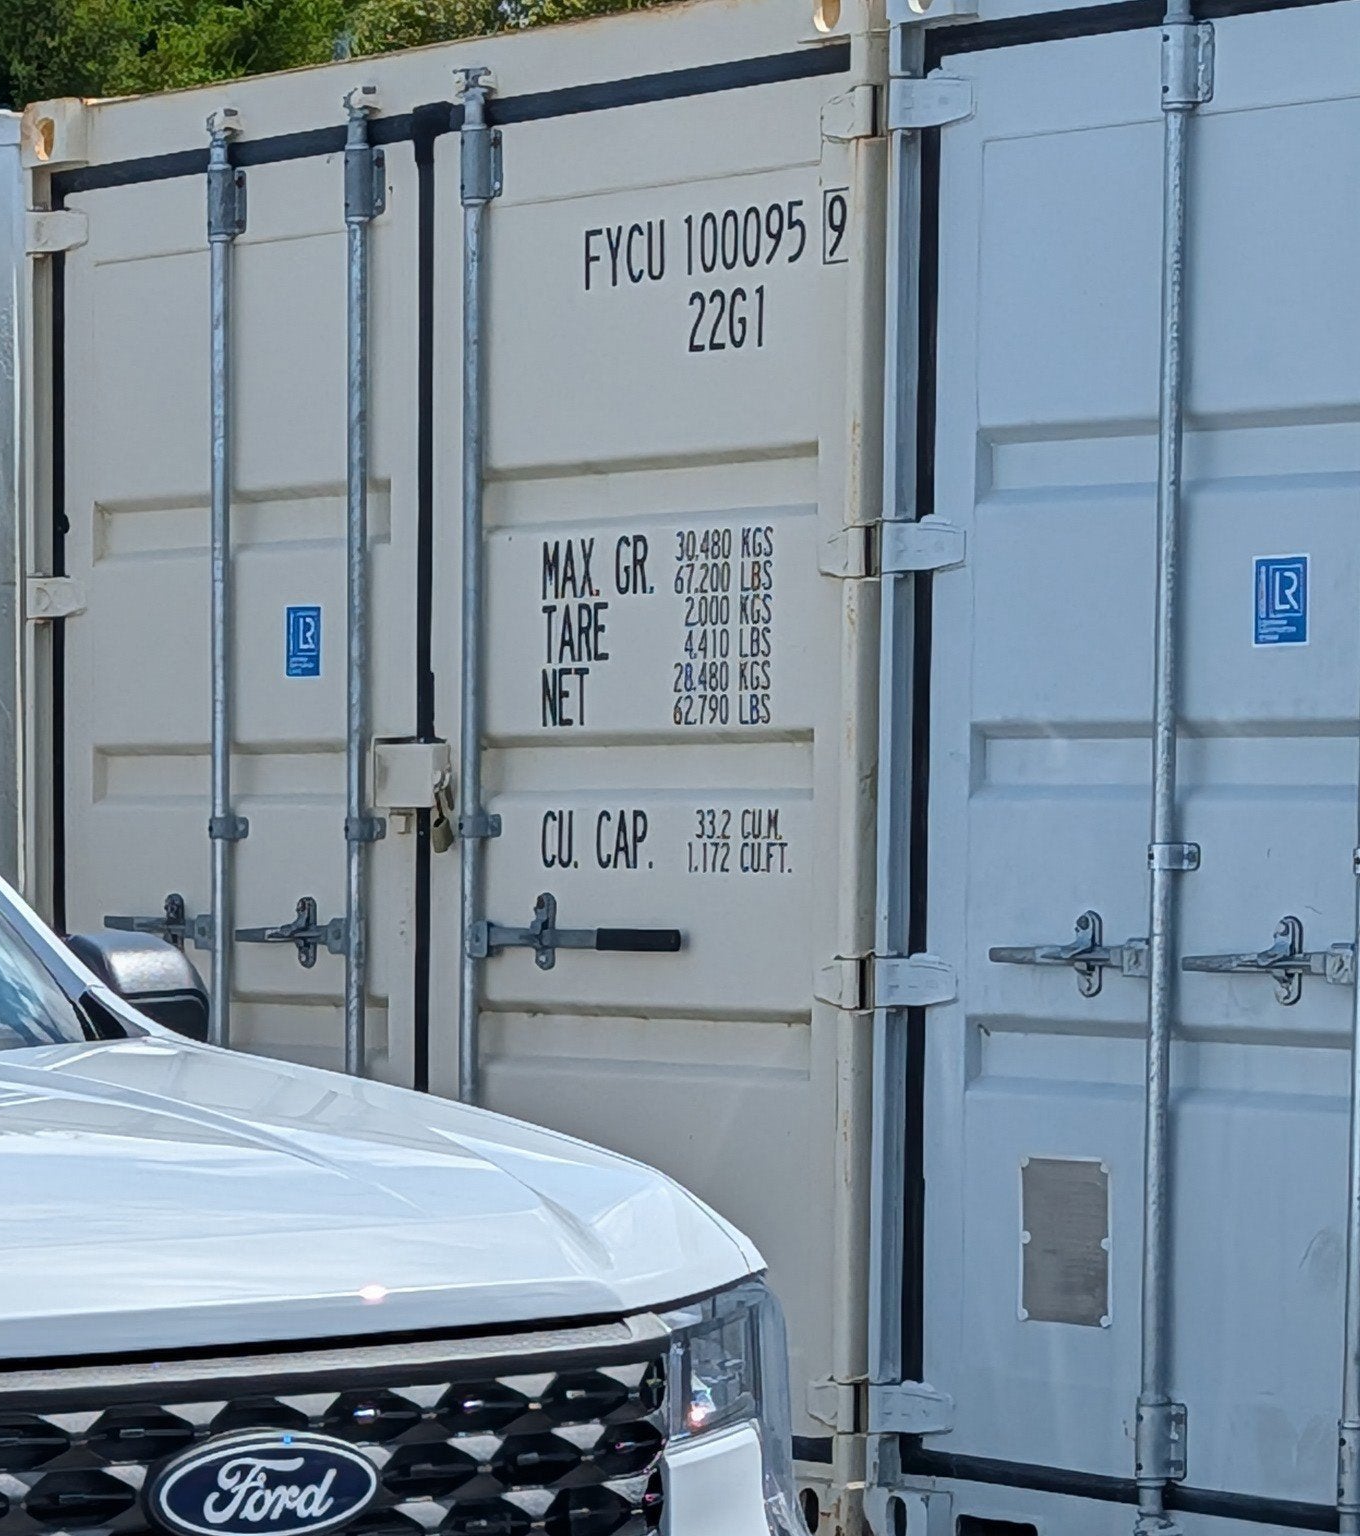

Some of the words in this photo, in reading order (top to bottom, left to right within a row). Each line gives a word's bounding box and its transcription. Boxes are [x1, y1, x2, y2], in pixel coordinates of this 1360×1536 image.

[584, 218, 666, 291] FYCU
[683, 199, 807, 277] 100095
[827, 193, 849, 258] 9
[688, 284, 765, 353] 22G1
[541, 537, 600, 601] MAX.
[615, 534, 655, 596] GR.
[675, 528, 732, 562] 30.480
[741, 526, 774, 558] KGS
[674, 561, 731, 594] 67.200
[740, 559, 773, 590] LBS
[541, 601, 610, 664] TARE
[739, 593, 772, 625] KGS
[739, 626, 771, 658] LBS
[541, 667, 590, 727] NET
[738, 660, 771, 692] KGS
[738, 693, 771, 725] LBS
[540, 809, 579, 870] CU.
[595, 809, 654, 870] CAP.
[202, 1456, 338, 1525] Ford
